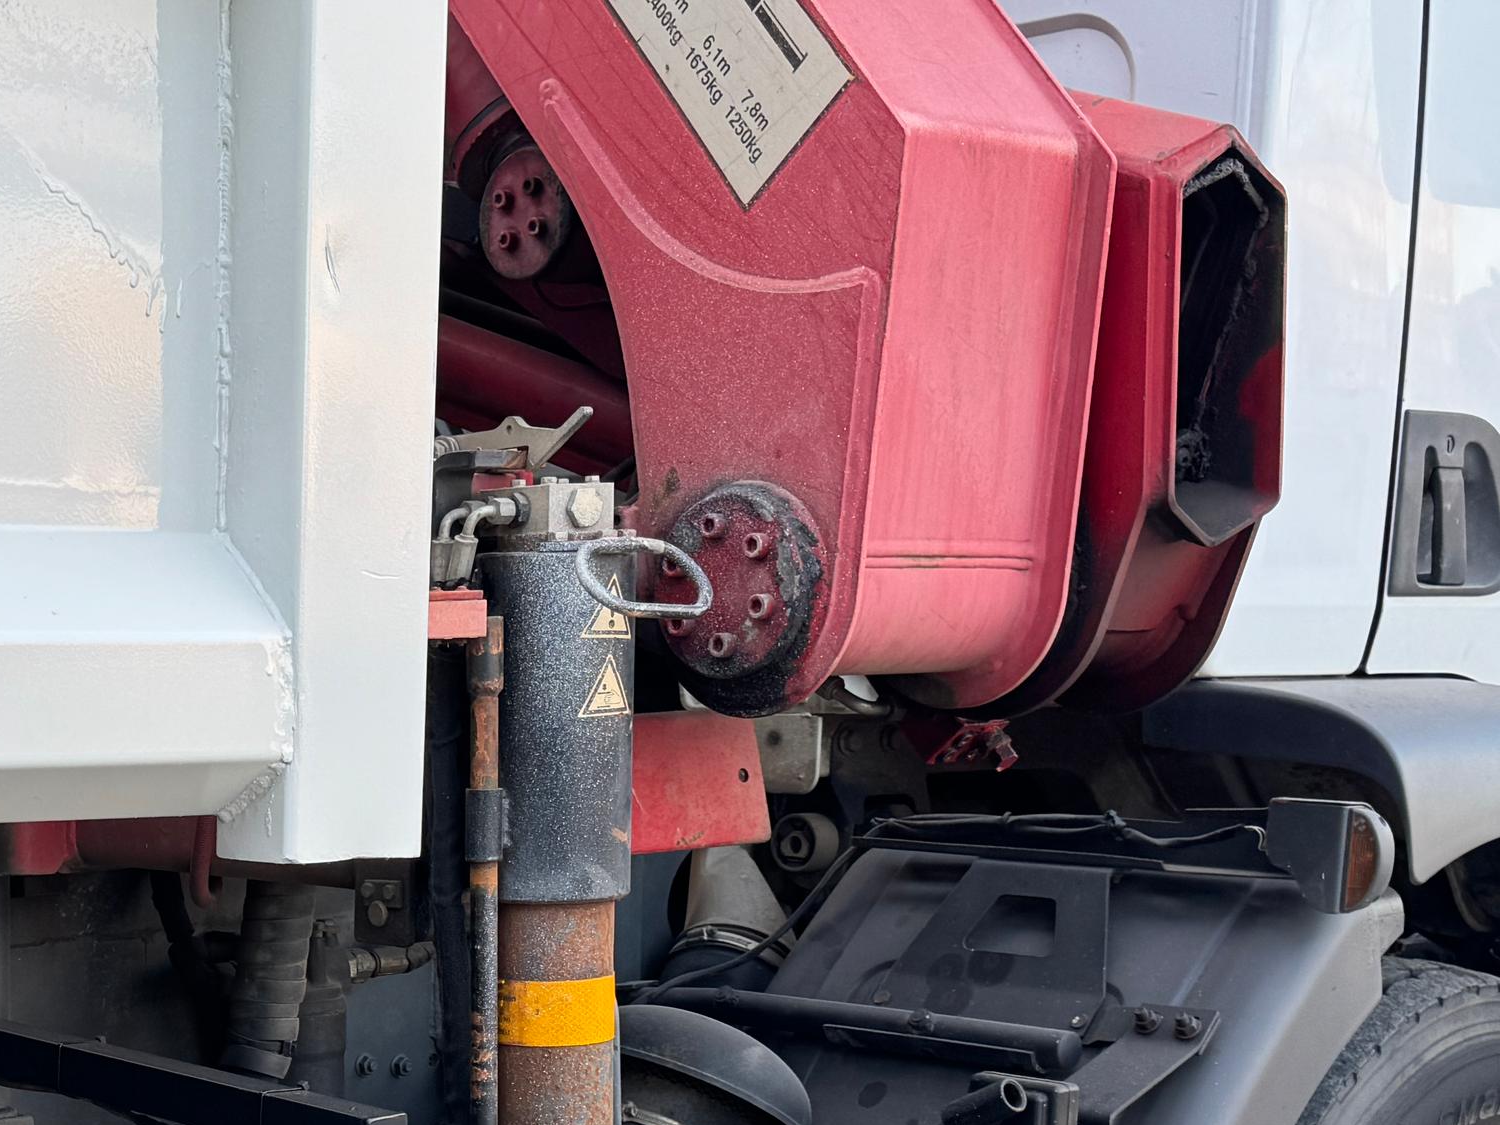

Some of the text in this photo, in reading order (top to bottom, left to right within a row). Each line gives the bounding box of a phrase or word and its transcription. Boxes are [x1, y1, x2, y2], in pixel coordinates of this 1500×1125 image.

[646, 0, 763, 164] 400kg 1675kg 1250kg
[703, 35, 731, 76] 6,1m
[741, 89, 769, 131] 7,8m
